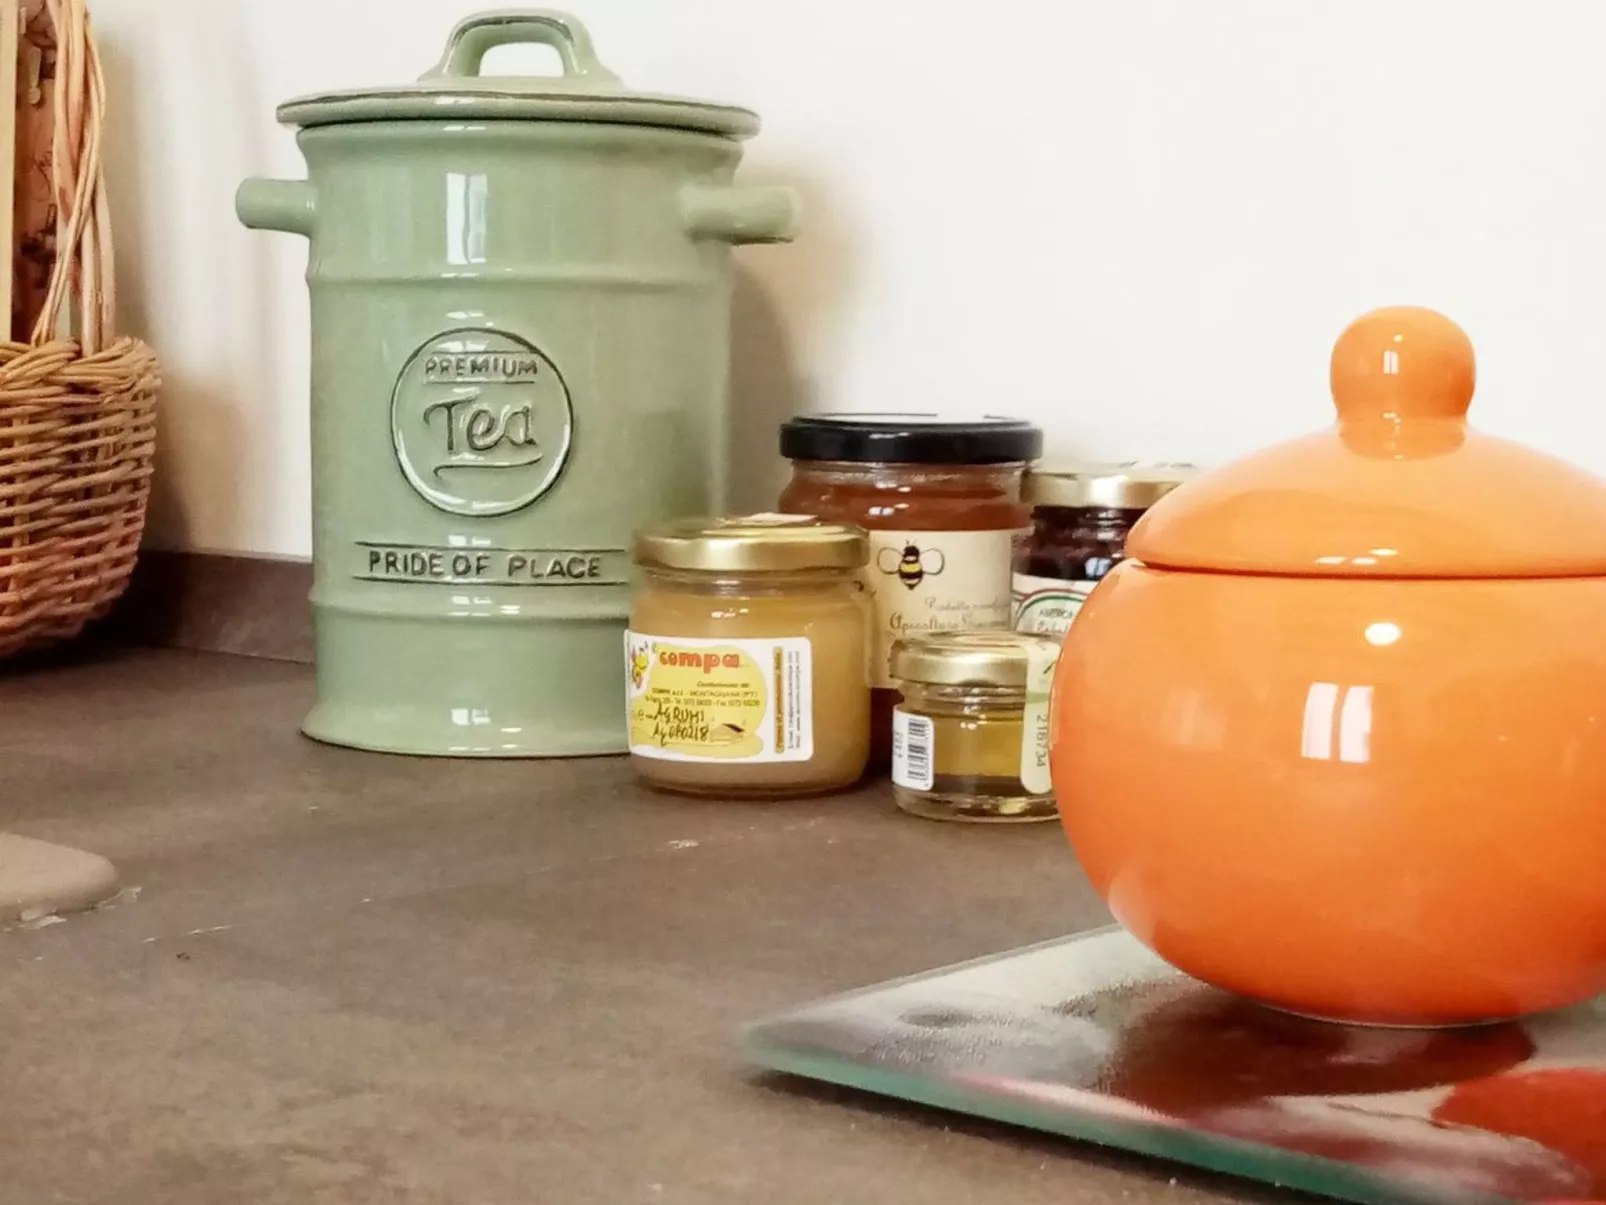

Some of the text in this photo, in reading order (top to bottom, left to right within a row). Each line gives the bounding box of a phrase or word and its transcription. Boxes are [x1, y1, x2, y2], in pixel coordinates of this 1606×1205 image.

[424, 356, 538, 377] PREMIUM
[422, 395, 539, 452] Tea
[368, 550, 602, 579] PRIDE OF PLACE
[659, 651, 740, 674] compa
